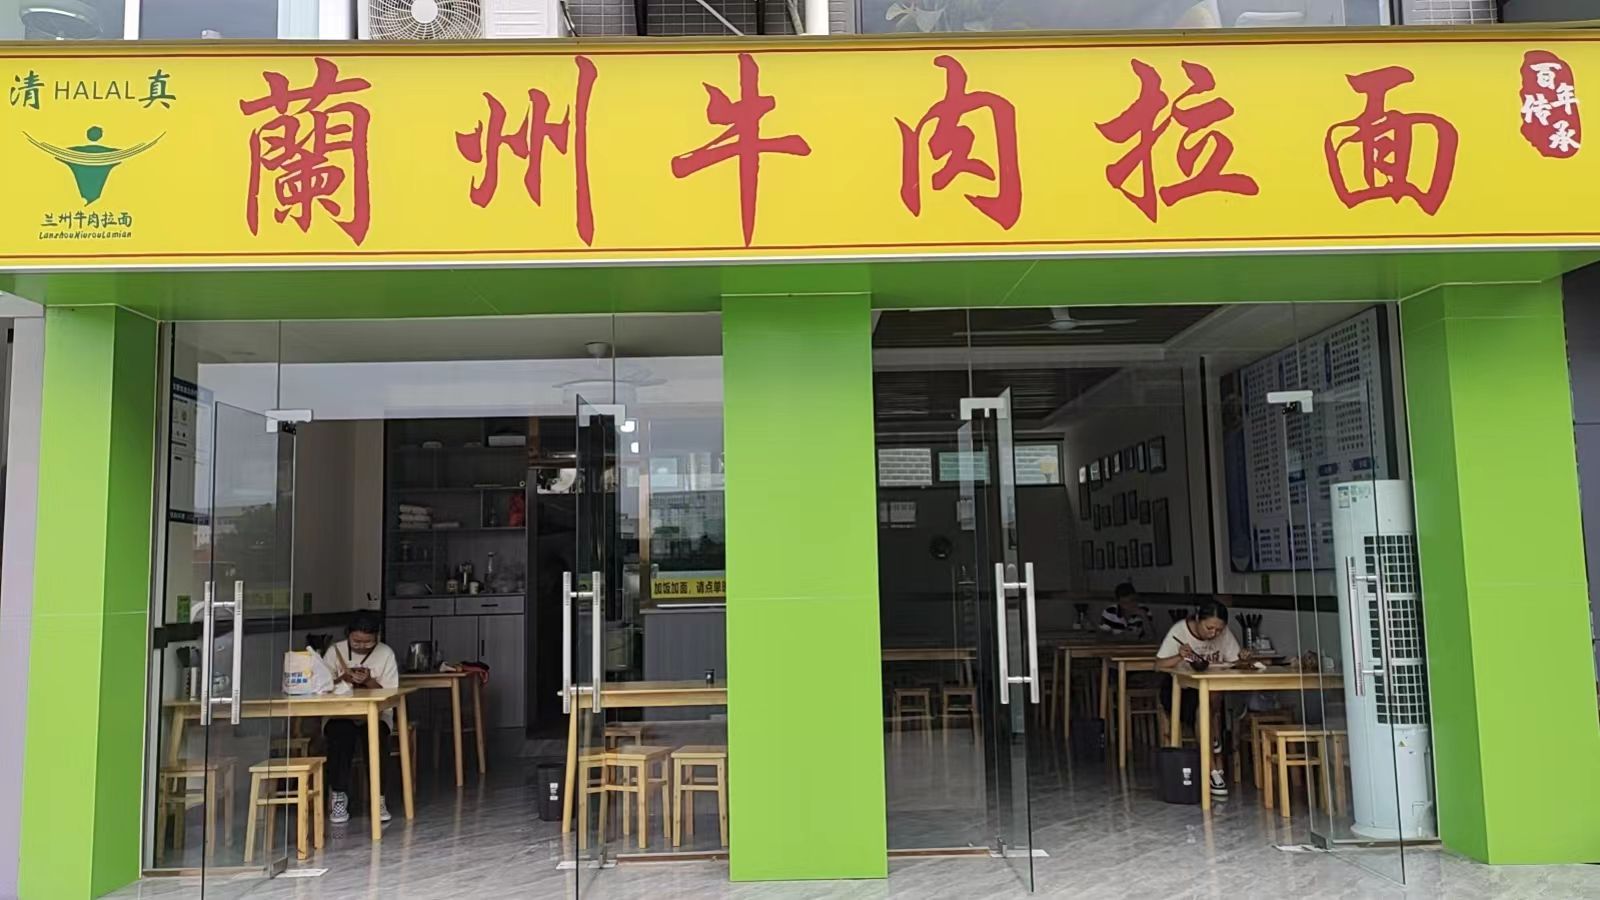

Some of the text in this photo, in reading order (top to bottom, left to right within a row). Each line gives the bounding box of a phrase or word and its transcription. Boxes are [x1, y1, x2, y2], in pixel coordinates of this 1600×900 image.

[54, 80, 136, 100] HALAL
[1521, 62, 1580, 152] 百年传承
[240, 54, 1459, 247] 蘭州牛肉拉面
[41, 211, 133, 229] 兰州牛肉拉面
